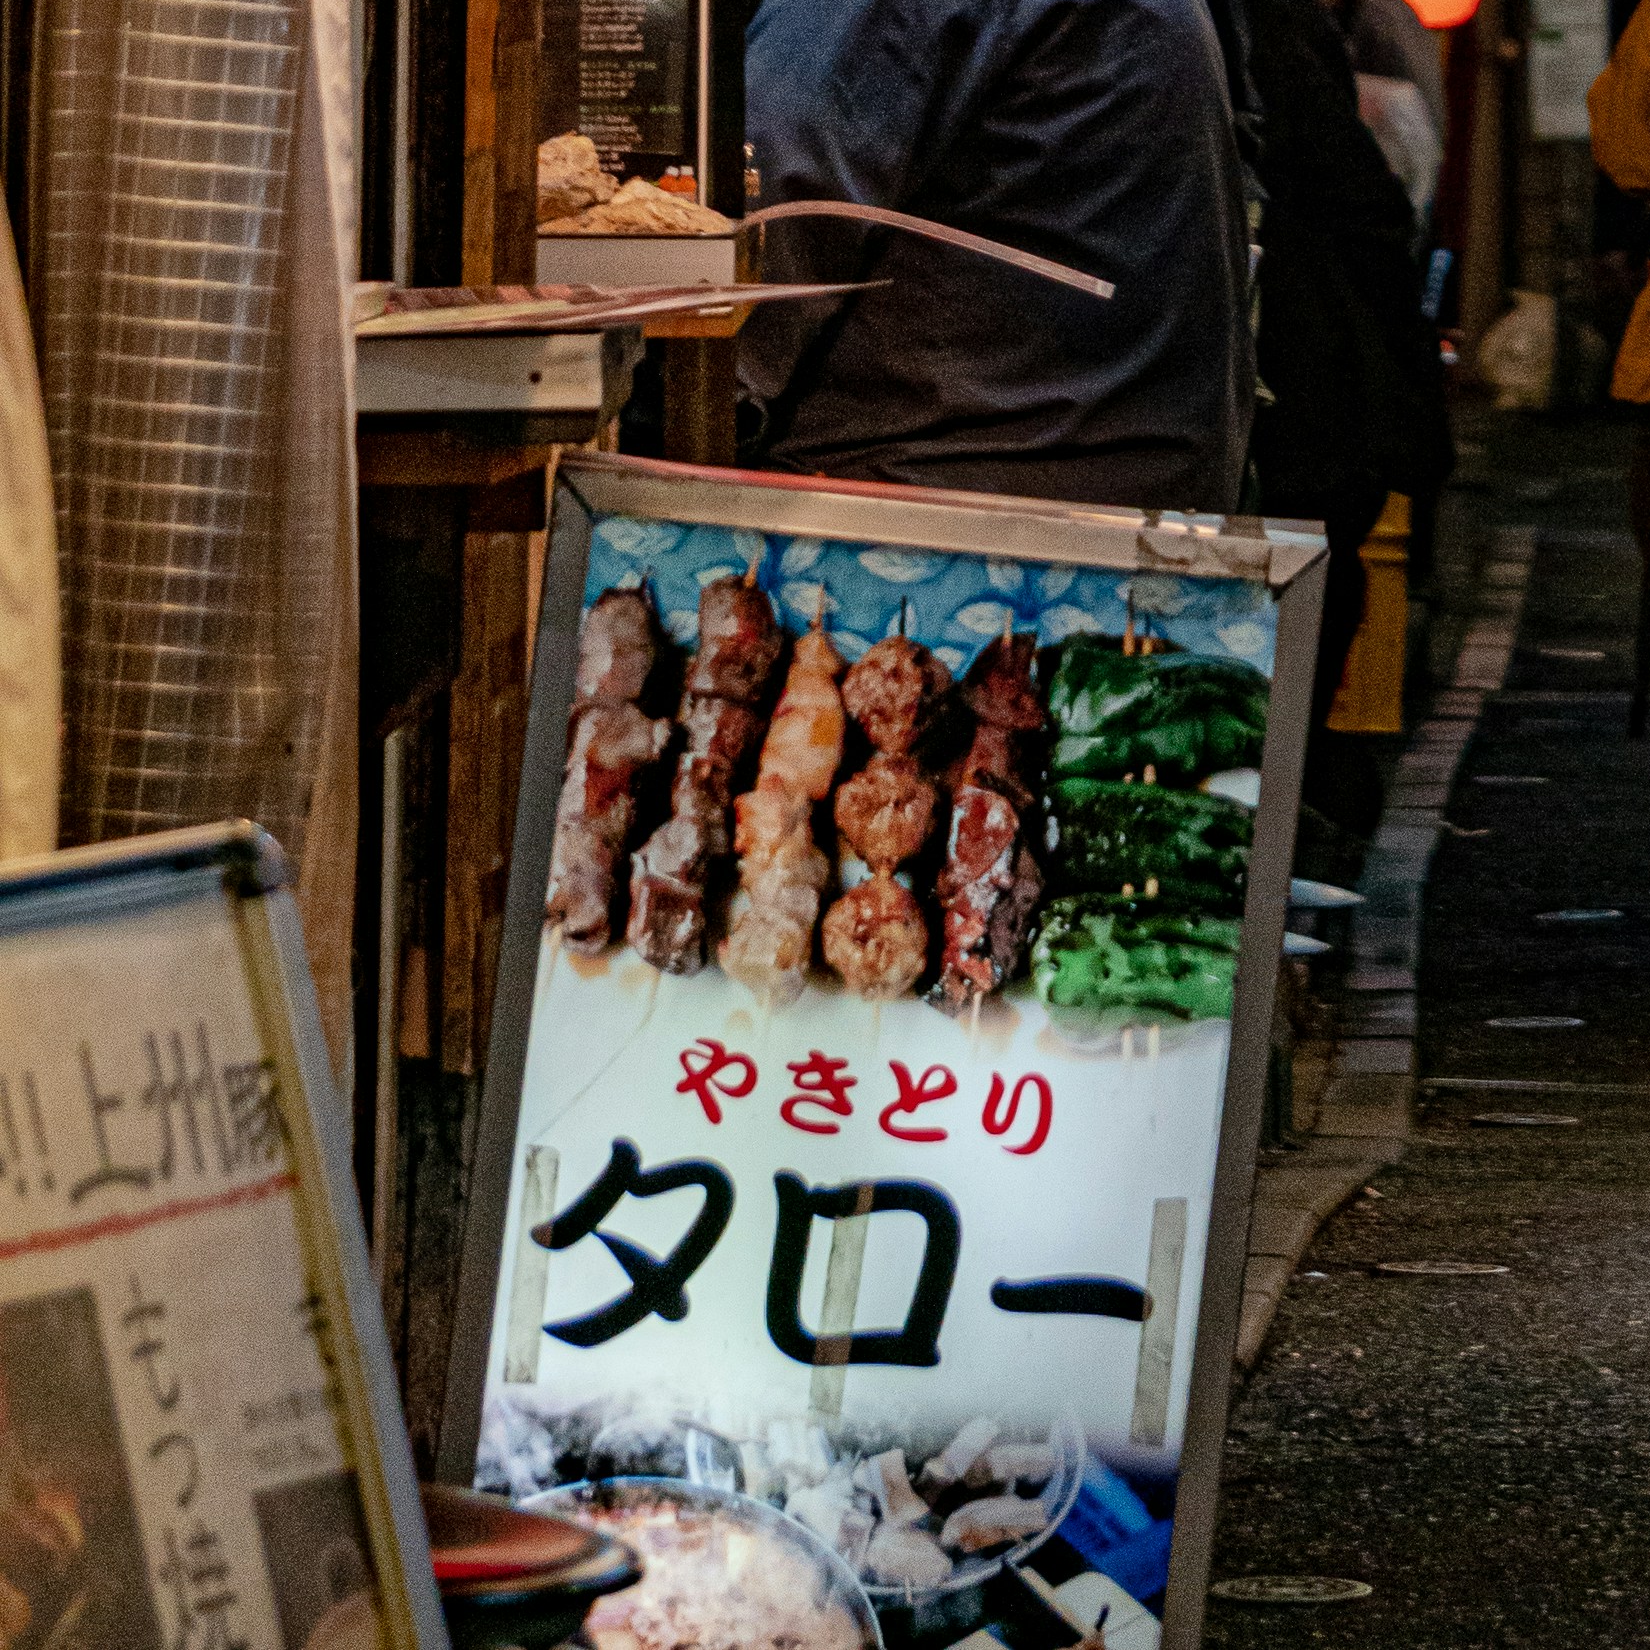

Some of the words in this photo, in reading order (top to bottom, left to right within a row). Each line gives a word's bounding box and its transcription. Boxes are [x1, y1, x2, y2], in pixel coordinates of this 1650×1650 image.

[676, 1039, 1054, 1155] やきとり
[530, 1138, 1153, 1368] タロー
